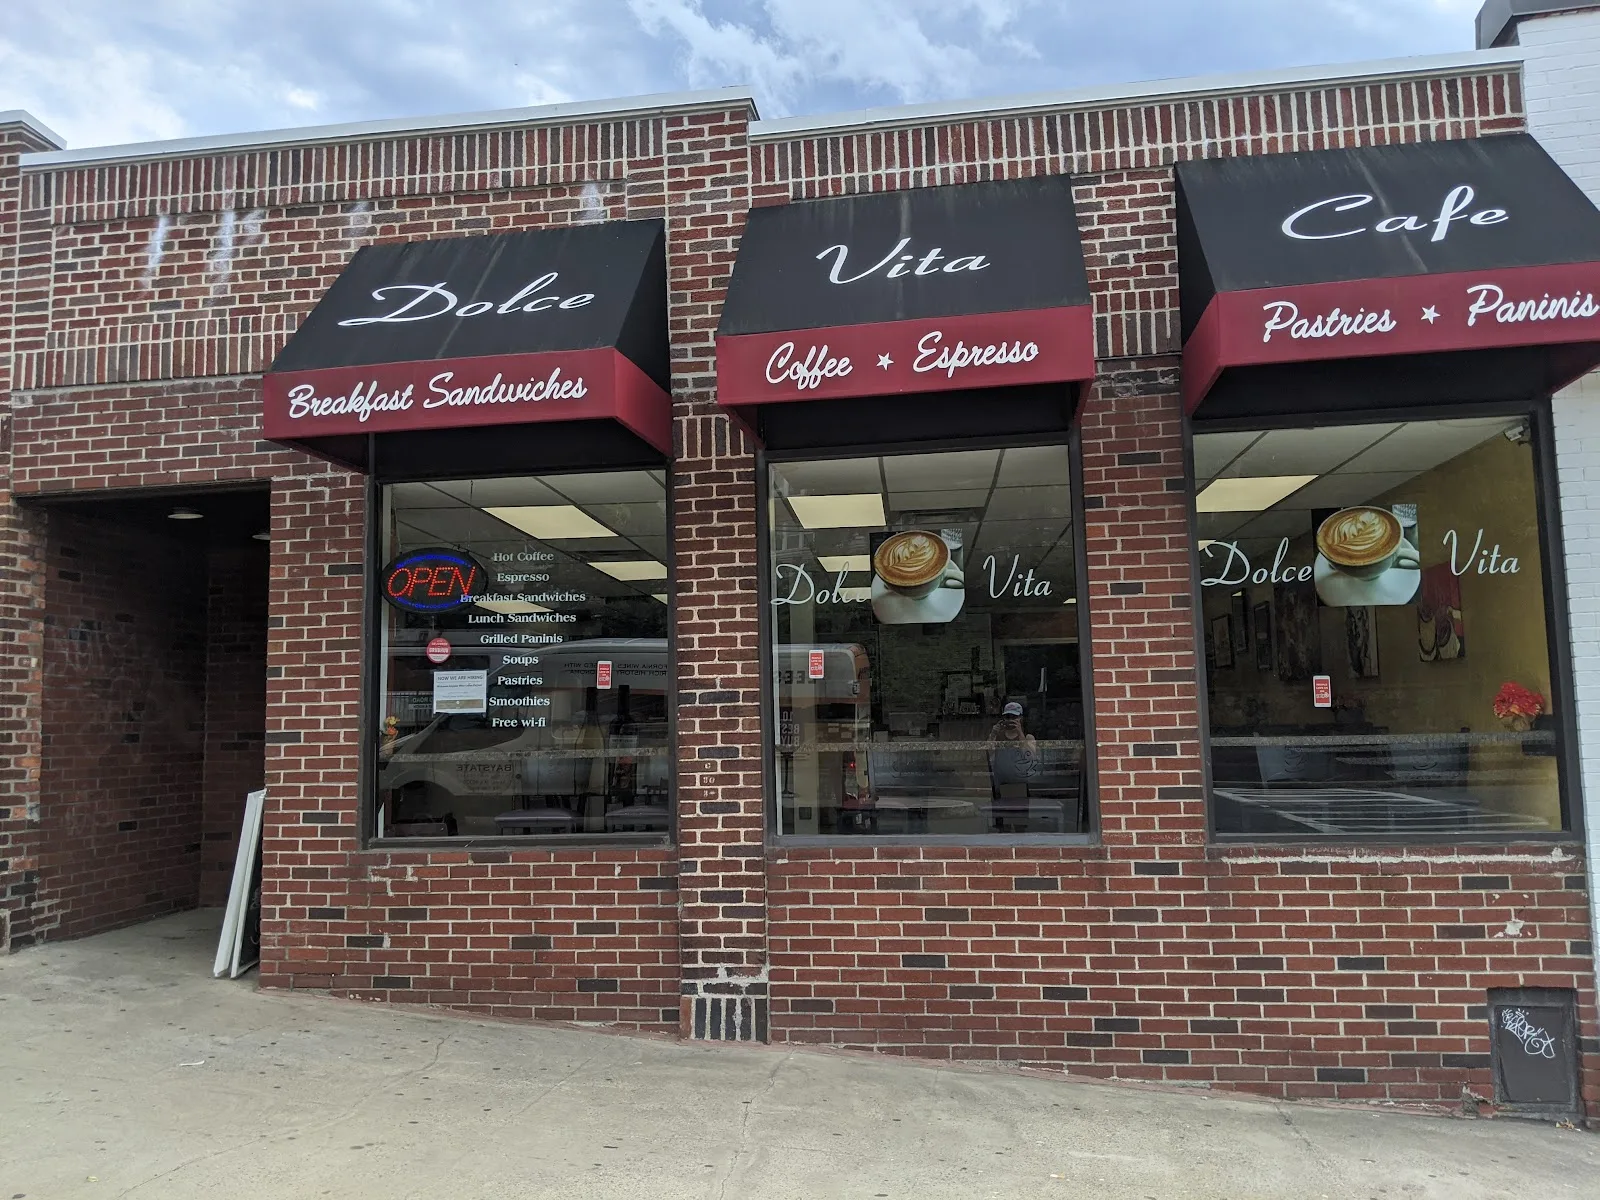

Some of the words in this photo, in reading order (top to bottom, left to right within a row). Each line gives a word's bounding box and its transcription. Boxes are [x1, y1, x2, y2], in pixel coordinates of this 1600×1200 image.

[1281, 185, 1509, 242] Cafe
[815, 237, 991, 285] Vita
[337, 271, 595, 327] Dolce
[1262, 300, 1397, 343] Pastries
[1466, 284, 1600, 326] Paninis
[765, 341, 853, 390] Coffee
[912, 331, 1040, 378] Espresso
[287, 379, 414, 422] Breakfast
[422, 366, 588, 409] Sandwiches
[493, 552, 514, 562] Hot
[517, 551, 555, 561] Coffee
[1200, 536, 1314, 587] Dolce
[1442, 528, 1521, 577] Vita
[387, 566, 478, 598] OPEN
[497, 572, 550, 584] Espresso
[982, 553, 1053, 600] Vita
[460, 592, 514, 603] Breakfast
[516, 591, 586, 602] Sandwiches
[468, 614, 504, 624] Lunch
[507, 612, 577, 623] Sandwiches
[480, 634, 518, 644] Grilled
[521, 633, 563, 643] Paninis
[502, 655, 539, 666] Soups
[497, 675, 543, 686] Pastries
[488, 696, 551, 707] Smoothies
[492, 717, 518, 728] Free
[521, 717, 547, 728] wi-fi
